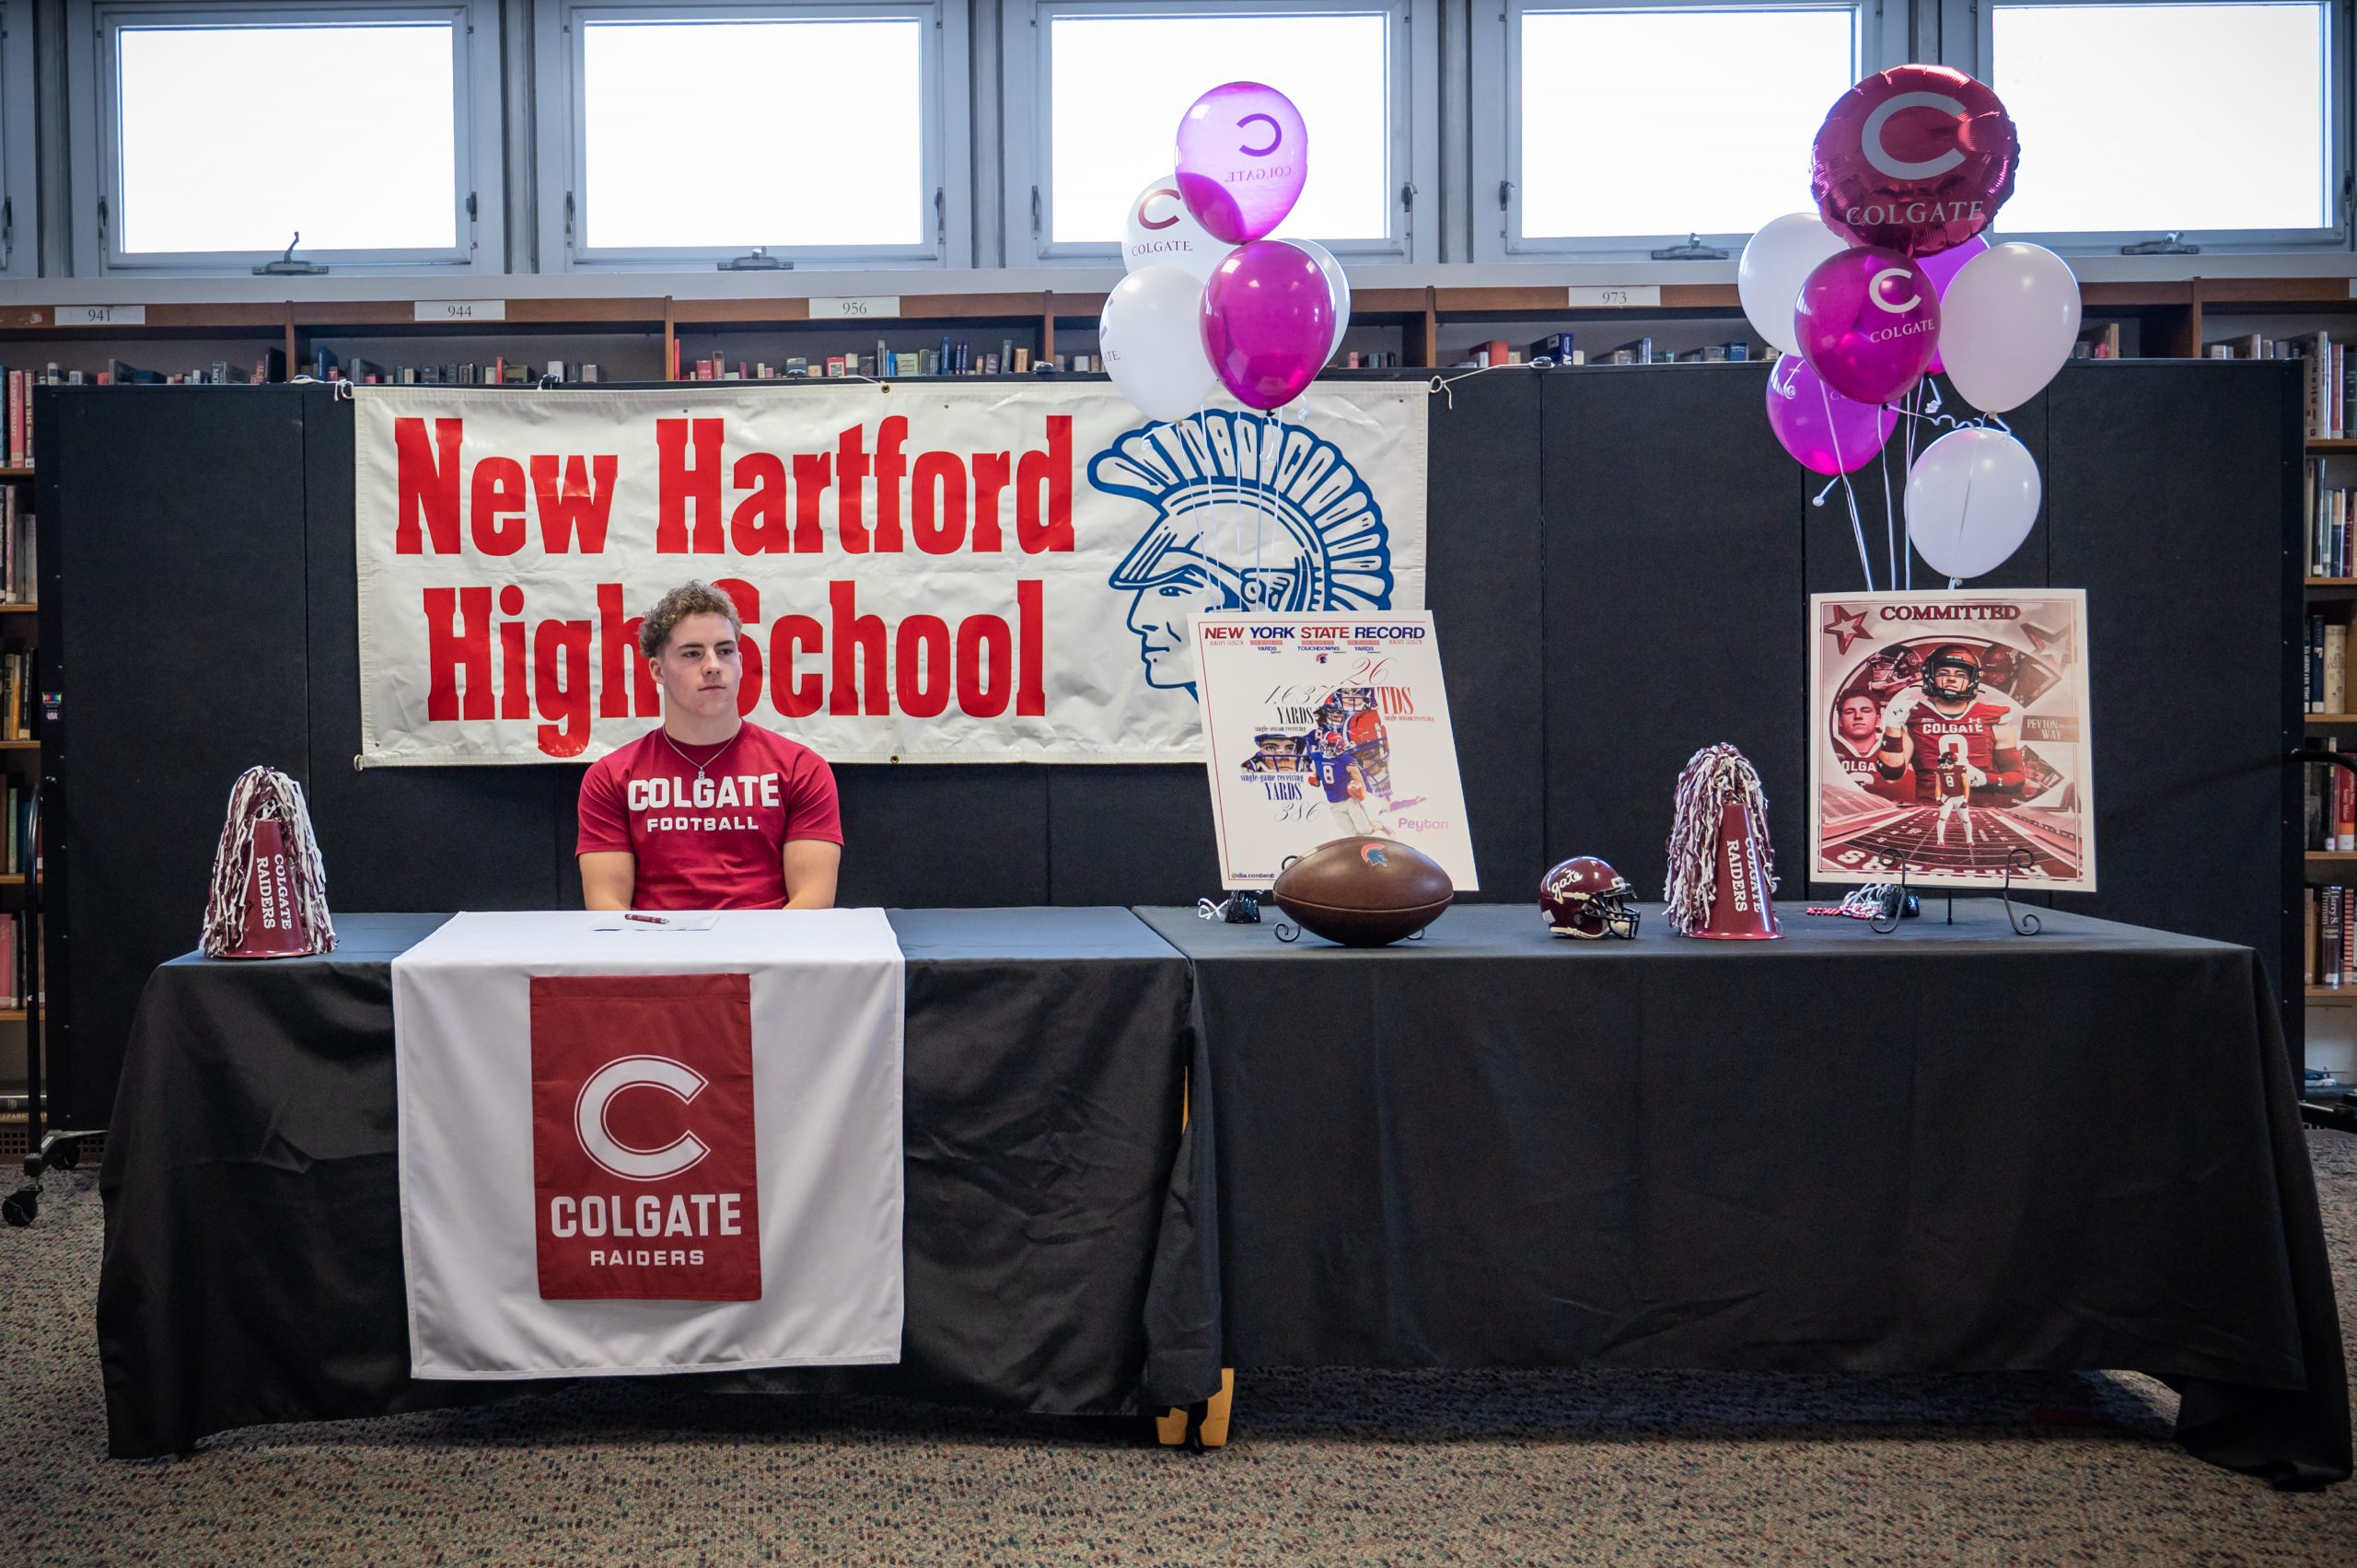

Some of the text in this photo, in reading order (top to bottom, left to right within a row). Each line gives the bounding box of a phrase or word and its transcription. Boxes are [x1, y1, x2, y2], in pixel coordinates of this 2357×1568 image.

[1861, 91, 1968, 180] C
[1138, 189, 1181, 230] C
[1846, 201, 1983, 226] COLGATE
[1132, 239, 1193, 257] COLGATE
[1602, 291, 1627, 305] 973
[1868, 268, 1922, 314] C
[87, 308, 112, 322] 941
[447, 305, 472, 318] 944
[842, 301, 867, 315] 956
[1870, 318, 1935, 343] COLGATE
[394, 414, 1074, 556] New Hartford
[1880, 605, 2021, 621] COMMITTED
[1204, 627, 1425, 639] NEW YORK STATE RECORD
[423, 583, 661, 758] High
[1341, 656, 1396, 686] 26
[1377, 687, 1414, 714] TDS
[1277, 707, 1315, 725] YARDS
[2026, 719, 2058, 729] PEYTON
[1922, 724, 1983, 734] COLGATE
[2041, 729, 2061, 739] WAY
[1323, 765, 1335, 784] 8
[1841, 761, 1876, 772] OLGA
[628, 772, 780, 811] COLGATE
[1265, 782, 1302, 800] YARDS
[647, 816, 759, 832] FOOTBALL
[1399, 818, 1449, 831] Peyton
[1726, 839, 1748, 912] RAIDERS
[1745, 837, 1762, 912] COLGATE
[256, 856, 276, 930] RAIDERS
[274, 854, 293, 931] COLGATE
[574, 1054, 712, 1182] C
[551, 1193, 742, 1238] COLGATE
[590, 1249, 705, 1266] RAIDERS
